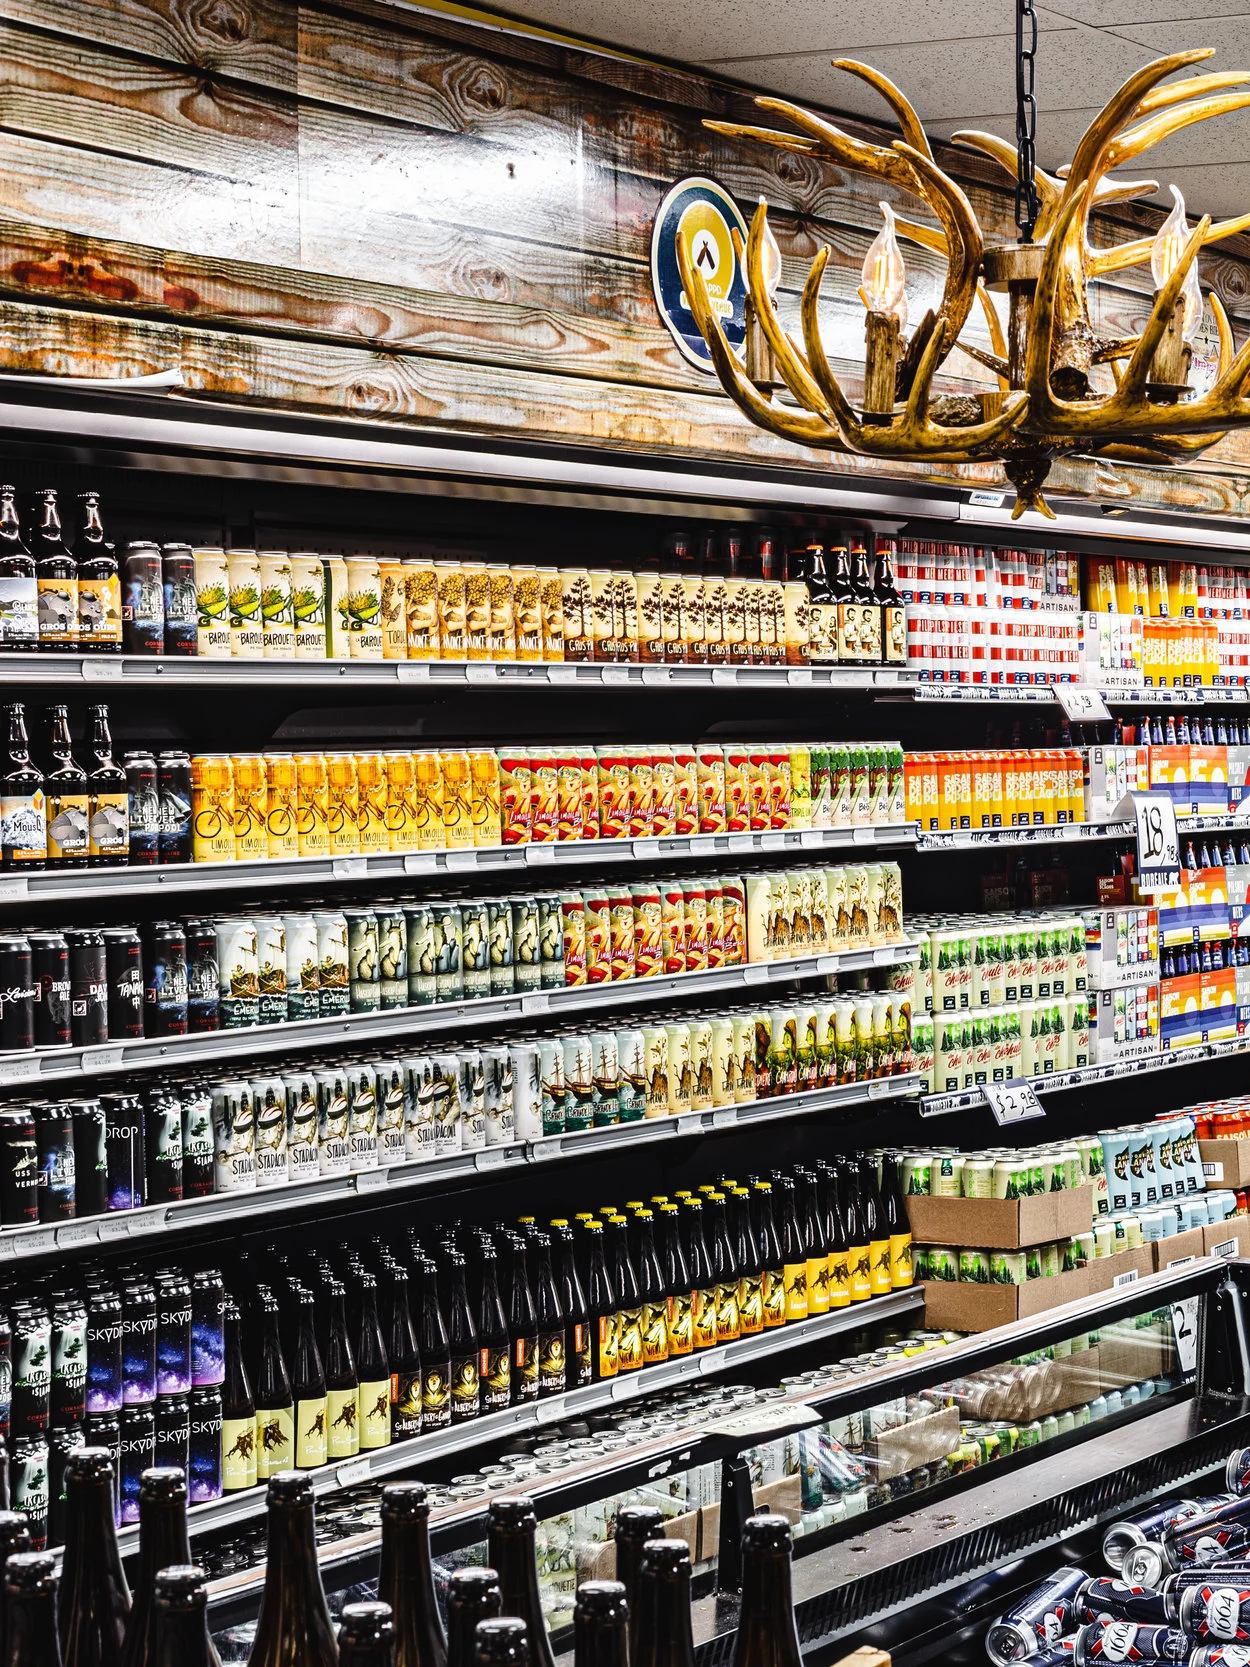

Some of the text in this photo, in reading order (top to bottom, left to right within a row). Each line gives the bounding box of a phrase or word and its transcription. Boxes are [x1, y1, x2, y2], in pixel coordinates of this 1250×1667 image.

[1040, 602, 1074, 611] ARTISAN
[40, 623, 67, 631] GROS
[93, 623, 117, 631] OURS
[1105, 677, 1138, 686] ARTISAN
[63, 838, 84, 847] GROS
[100, 836, 124, 845] GROS
[1141, 872, 1169, 888] BORÉALE
[1121, 969, 1154, 982] ARTISAN
[1119, 1046, 1154, 1059] ARTISAN
[995, 1091, 1037, 1119] $2,98
[15, 1170, 31, 1178] USS
[1214, 1596, 1237, 1637] 1664
[1110, 1623, 1133, 1654] 1664
